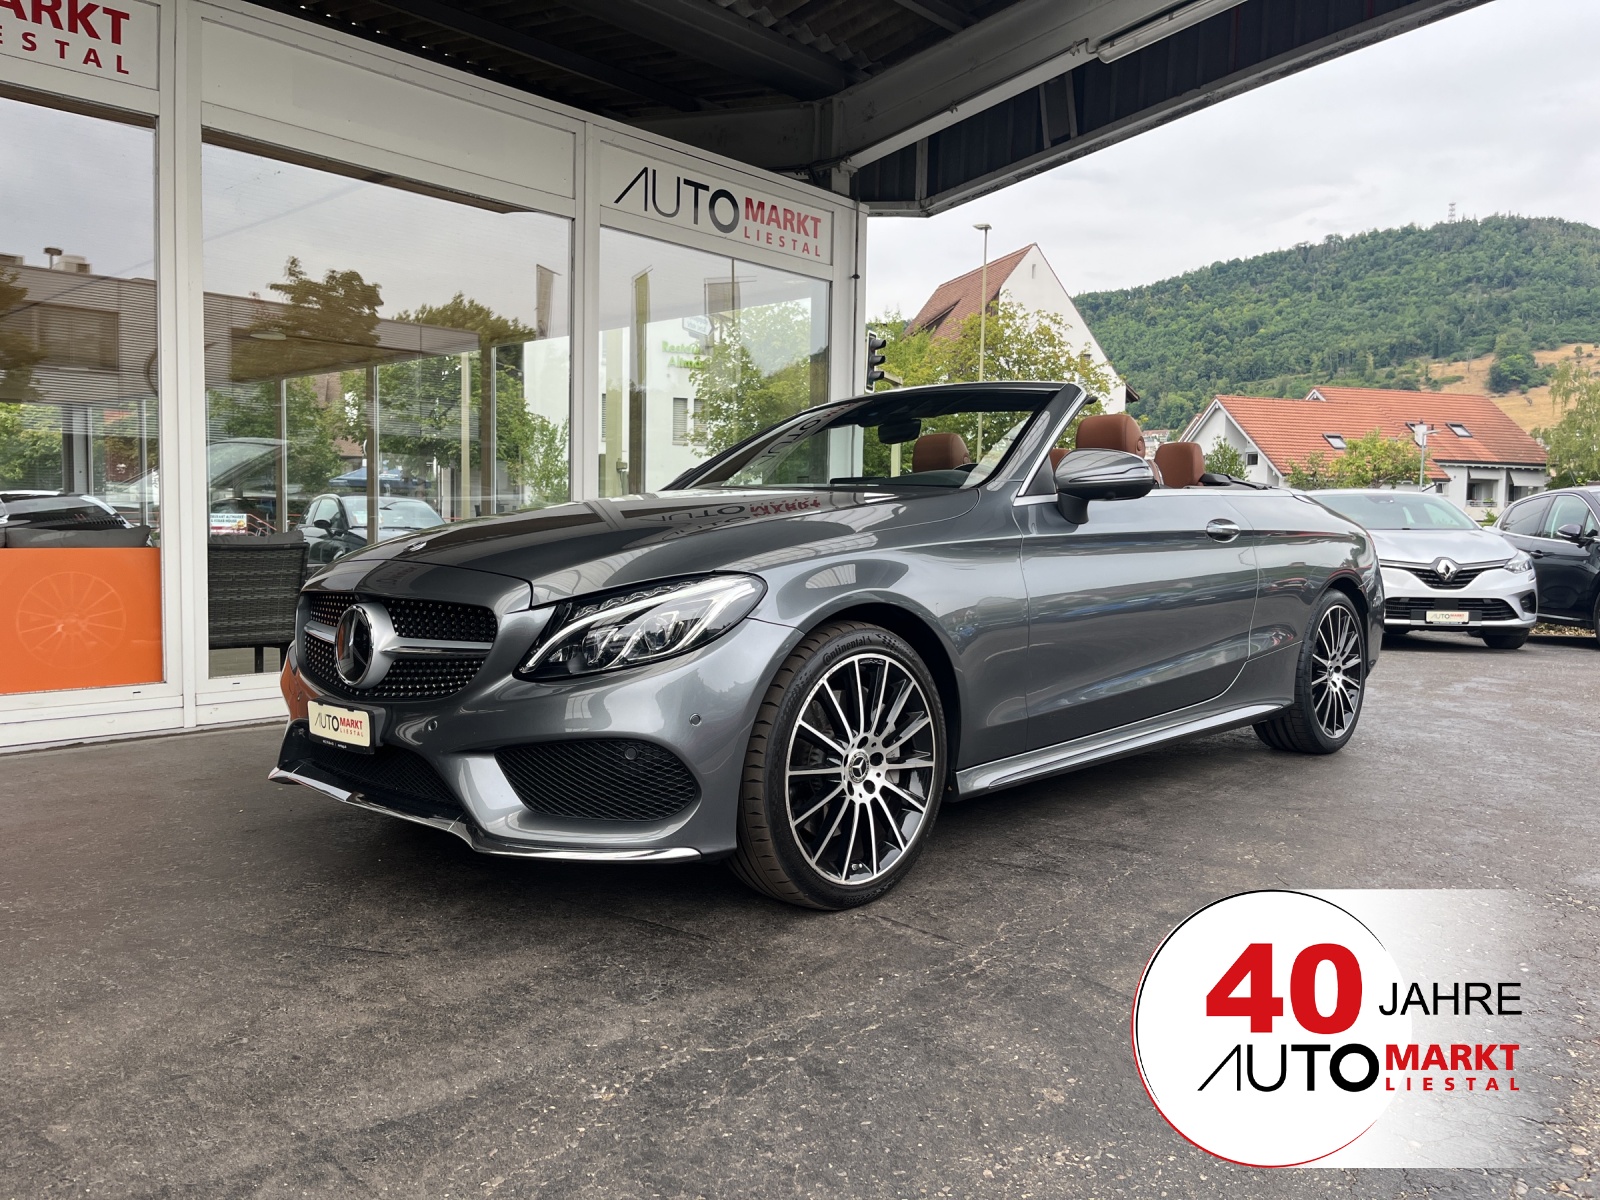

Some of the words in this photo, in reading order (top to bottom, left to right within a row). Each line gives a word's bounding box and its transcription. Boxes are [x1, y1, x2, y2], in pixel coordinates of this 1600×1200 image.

[0, 25, 129, 75] STAL
[614, 166, 740, 234] AUTO
[744, 196, 822, 240] MARKT
[744, 225, 821, 257] LIESTAL
[822, 635, 866, 666] Continental
[315, 712, 340, 732] AUTO
[340, 717, 363, 730] MARKT
[340, 727, 364, 738] LIESTAL
